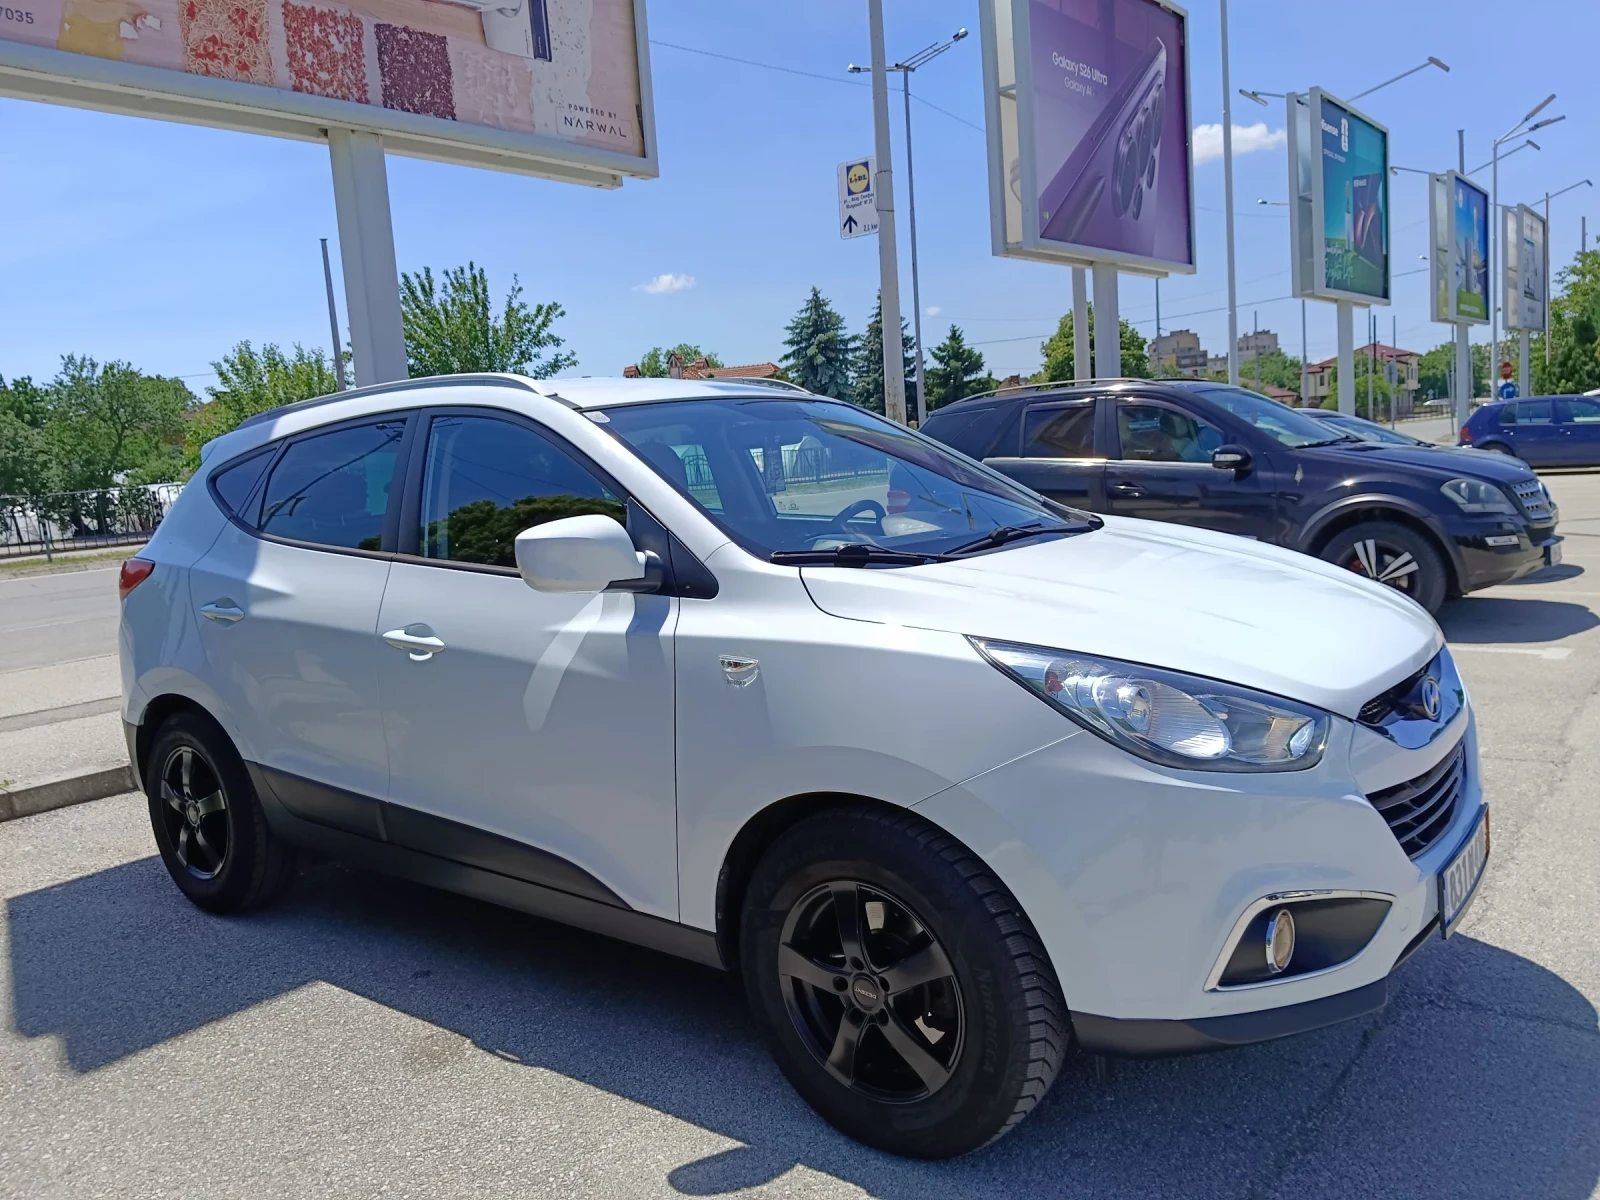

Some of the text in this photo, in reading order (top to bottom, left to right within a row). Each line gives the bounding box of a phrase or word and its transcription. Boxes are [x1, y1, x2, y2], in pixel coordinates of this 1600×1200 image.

[1052, 51, 1108, 86] Galaxy S26 Ultra
[1064, 76, 1086, 96] Galaxy
[568, 104, 617, 119] POWERED BY
[564, 116, 627, 138] NARWAL
